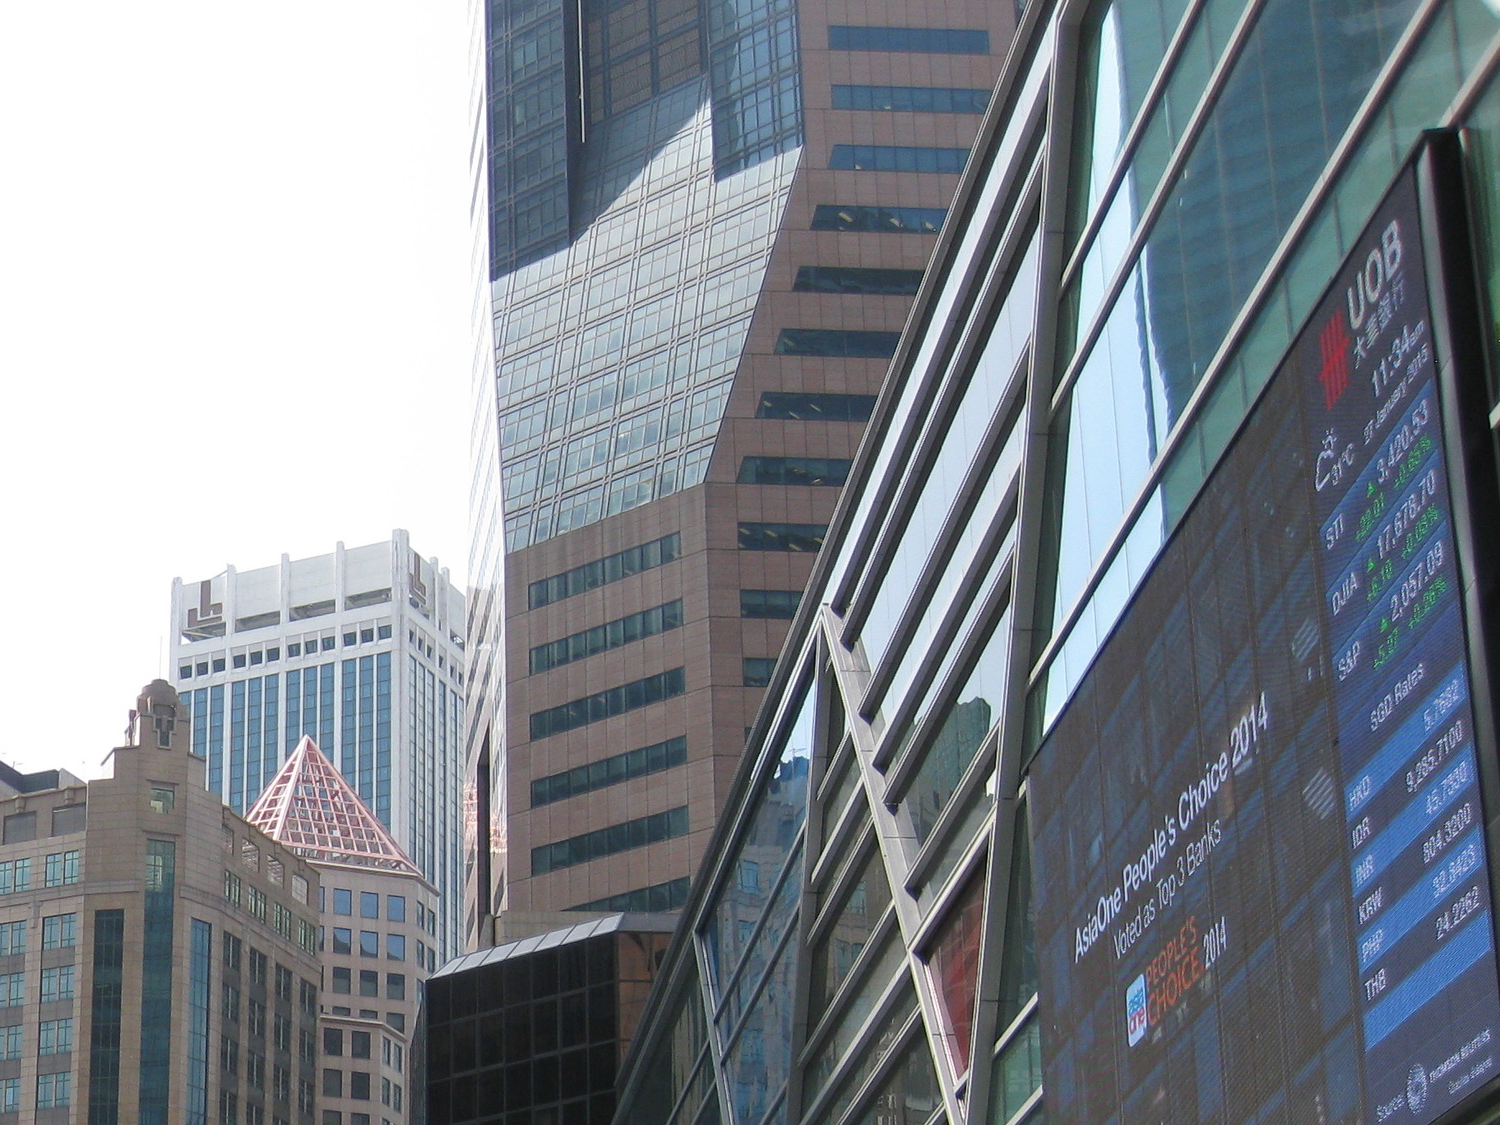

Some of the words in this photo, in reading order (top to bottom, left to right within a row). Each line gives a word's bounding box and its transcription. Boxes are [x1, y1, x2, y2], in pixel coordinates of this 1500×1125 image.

[1348, 220, 1403, 330] UOB
[1376, 378, 1407, 429] January
[1407, 343, 1428, 385] 2015
[1326, 513, 1344, 550] STI
[1377, 399, 1428, 485] 3,420.53
[1332, 572, 1358, 616] DJIA
[1378, 469, 1436, 559] 17,678.70
[1338, 641, 1360, 681] S&P
[1391, 540, 1443, 622] 2,057.09
[1370, 693, 1393, 732] SGD
[1394, 663, 1424, 706] Rates
[1074, 886, 1122, 964] AsiaOne
[1123, 815, 1176, 902] People's
[1178, 752, 1228, 831] Choice
[1230, 691, 1268, 768] 2014
[1350, 775, 1370, 811] HKD
[1352, 816, 1371, 849] IDR
[1113, 906, 1142, 960] Voted
[1143, 897, 1156, 928] as
[1156, 873, 1176, 910] Top
[1176, 857, 1185, 887] 3
[1185, 819, 1221, 877] Banks
[1356, 854, 1374, 887] INR
[1358, 887, 1382, 925] KRW
[1145, 915, 1197, 988] PEOPLE'S
[1148, 947, 1200, 1026] CHOICE
[1203, 916, 1227, 969] 2014
[1362, 928, 1384, 963] PHP
[1365, 968, 1386, 1001] THB
